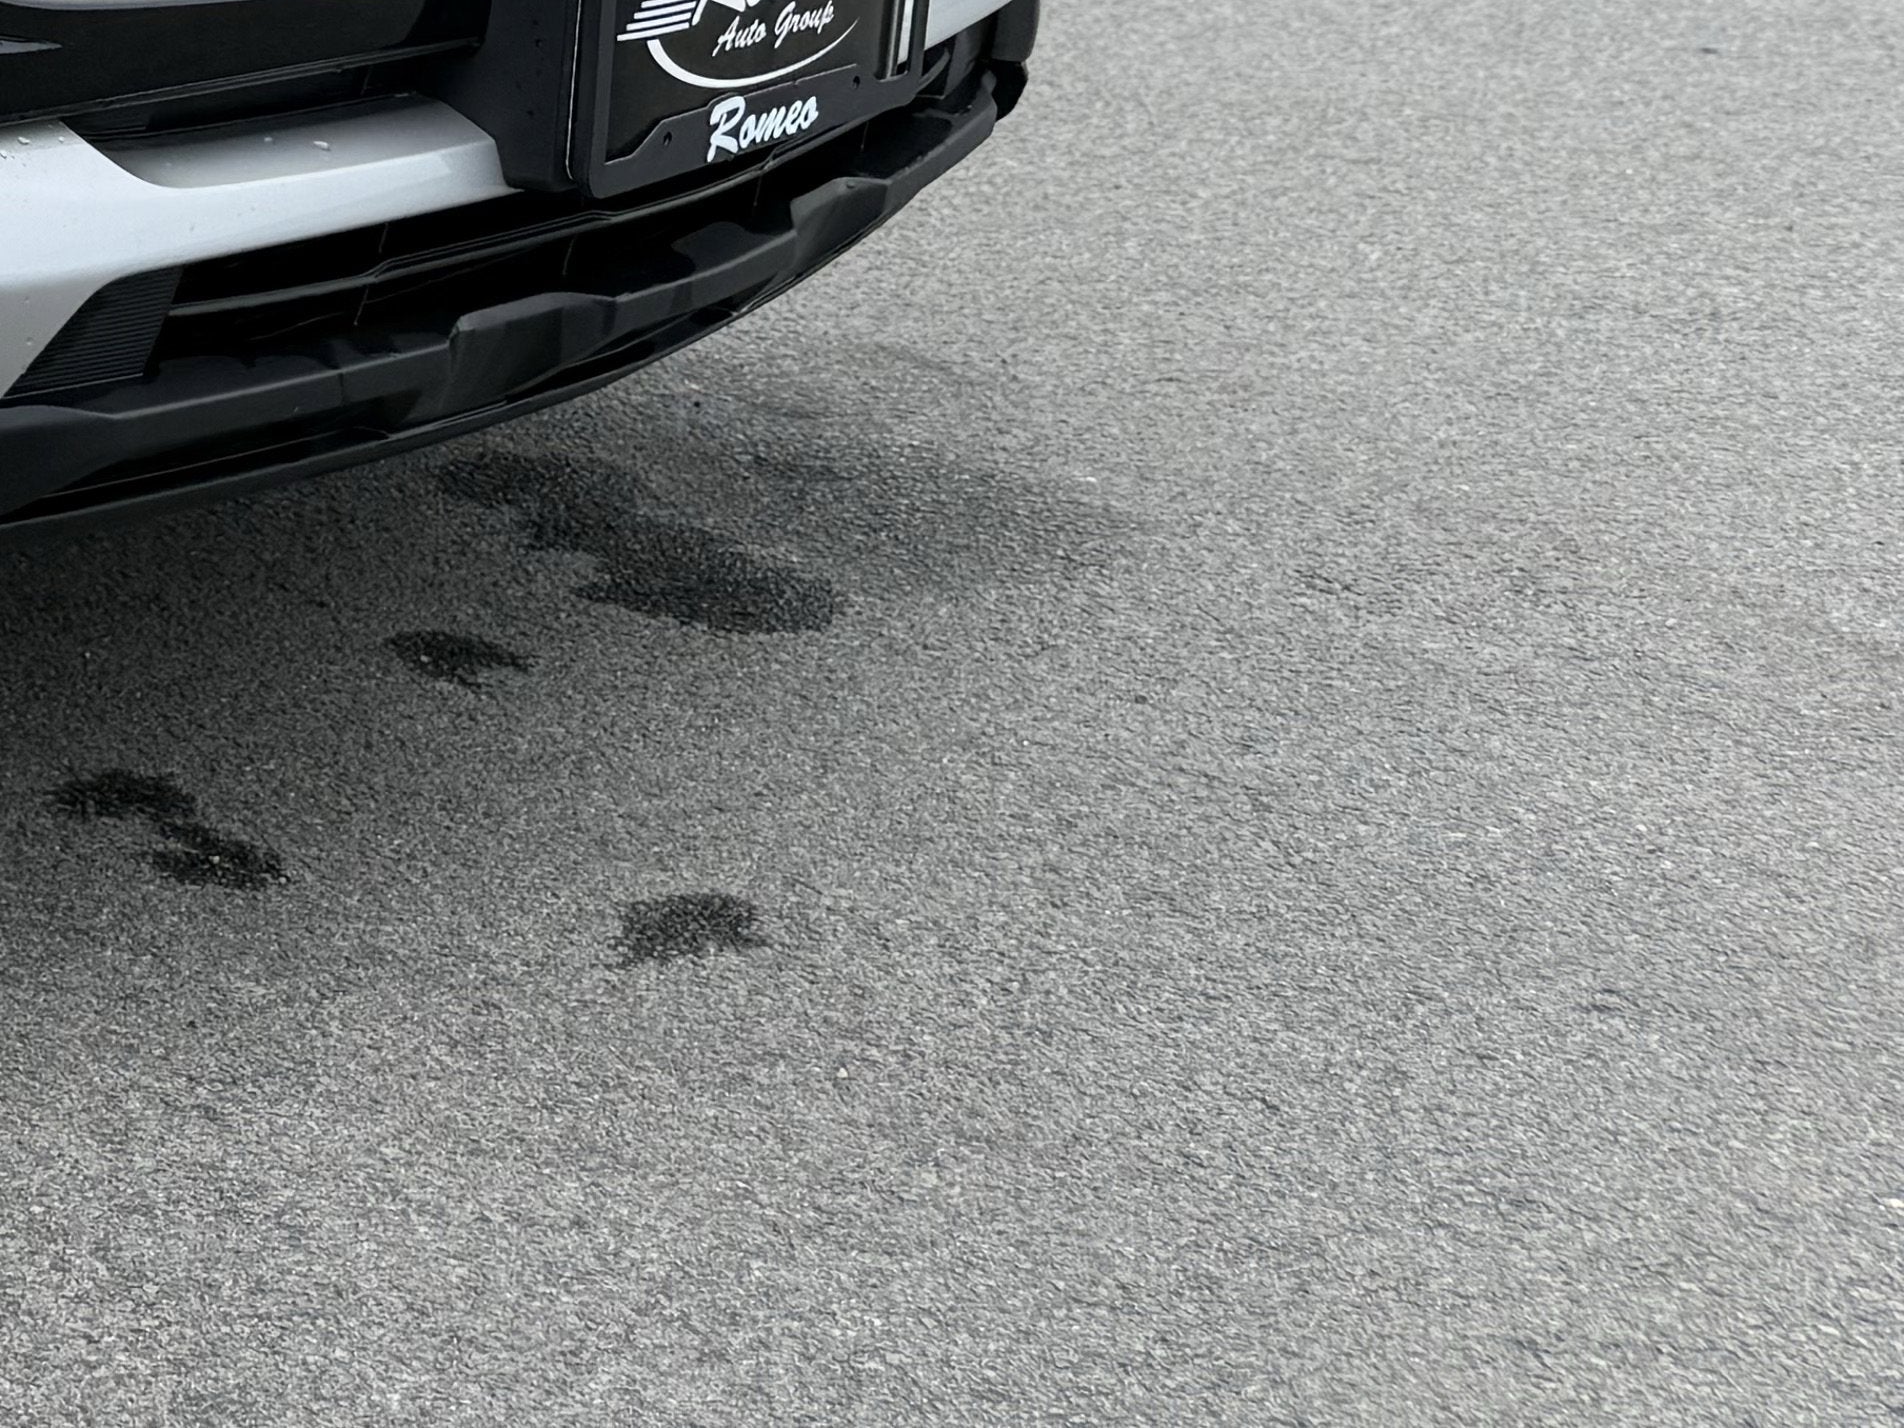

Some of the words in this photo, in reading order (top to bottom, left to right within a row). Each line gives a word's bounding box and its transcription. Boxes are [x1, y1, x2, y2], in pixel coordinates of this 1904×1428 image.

[712, 14, 766, 57] Auto
[773, 0, 835, 49] Group
[706, 96, 820, 163] Romeo
